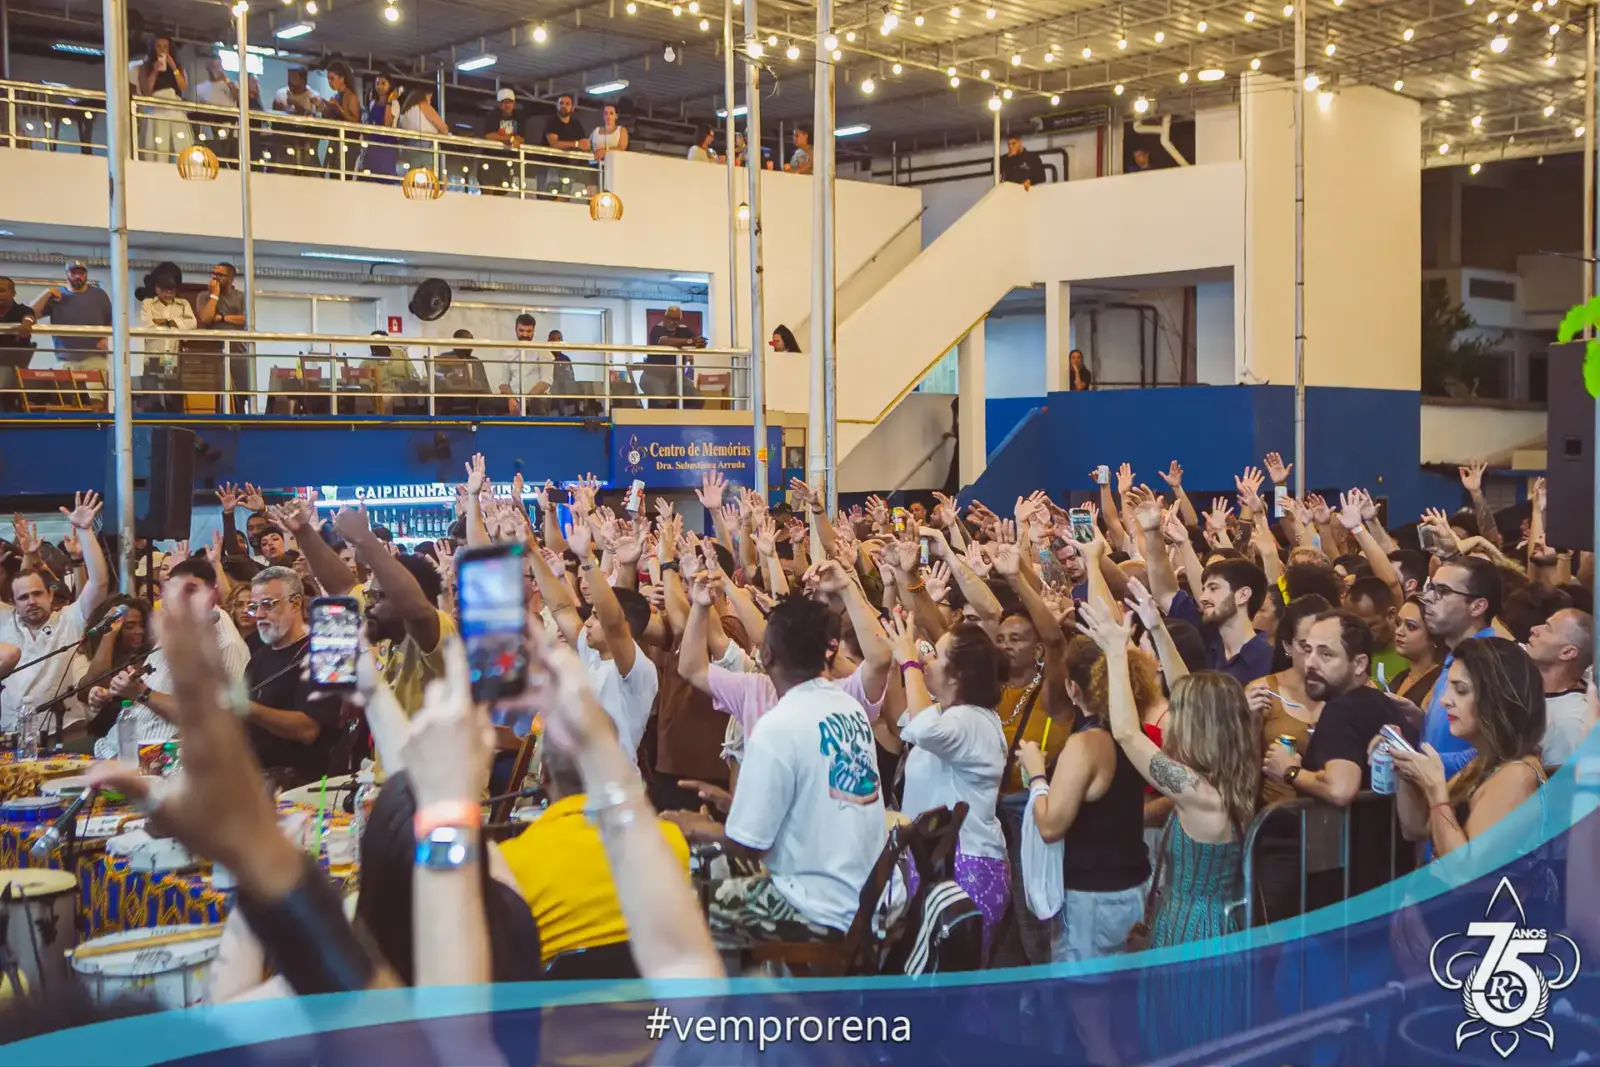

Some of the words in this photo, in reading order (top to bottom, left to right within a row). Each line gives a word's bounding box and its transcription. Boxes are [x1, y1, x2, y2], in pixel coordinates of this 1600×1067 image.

[650, 441, 685, 457] Centro
[687, 441, 700, 457] de
[702, 441, 750, 457] Memórias
[656, 461, 673, 470] Dra.
[718, 460, 745, 469] Arruda
[355, 485, 456, 499] CAIPIRINHAS
